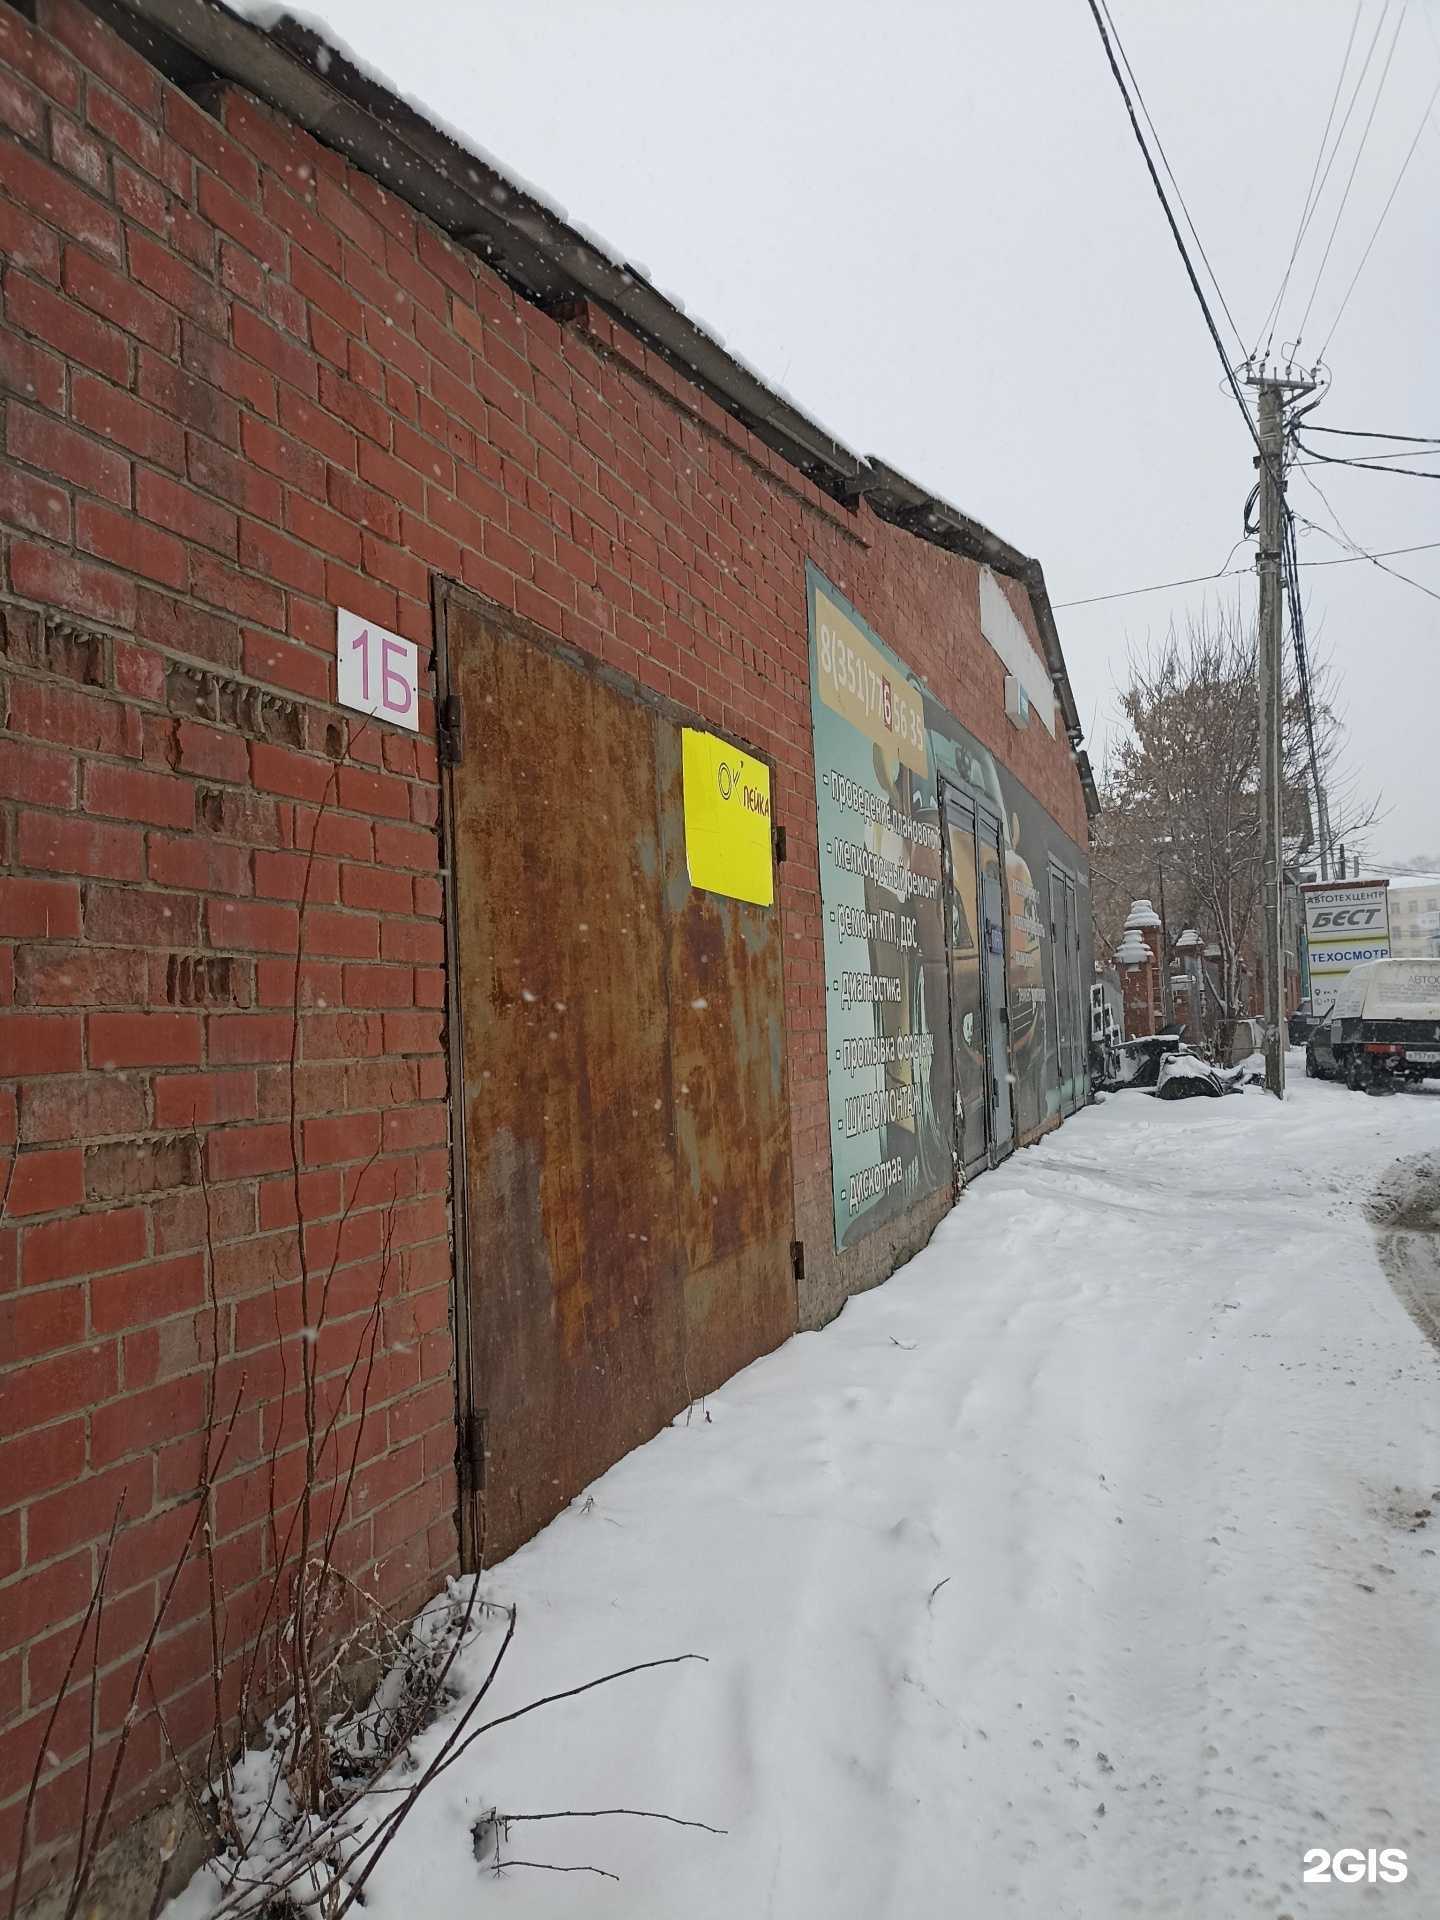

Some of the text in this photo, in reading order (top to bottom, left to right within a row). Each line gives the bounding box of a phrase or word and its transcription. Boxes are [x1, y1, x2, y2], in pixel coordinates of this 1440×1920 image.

[352, 629, 411, 713] 1Б
[831, 771, 891, 831] проведение
[1307, 891, 1384, 904] АВТОТЕХЦЕНТР
[838, 904, 878, 943] ремонт
[1312, 908, 1381, 928] БЕСТ
[1311, 949, 1389, 962] ТЕХОСМОТР
[841, 972, 902, 1010] диагностика
[843, 1036, 895, 1077] промывка
[846, 1081, 922, 1138] ШИНОМОНТАЖ
